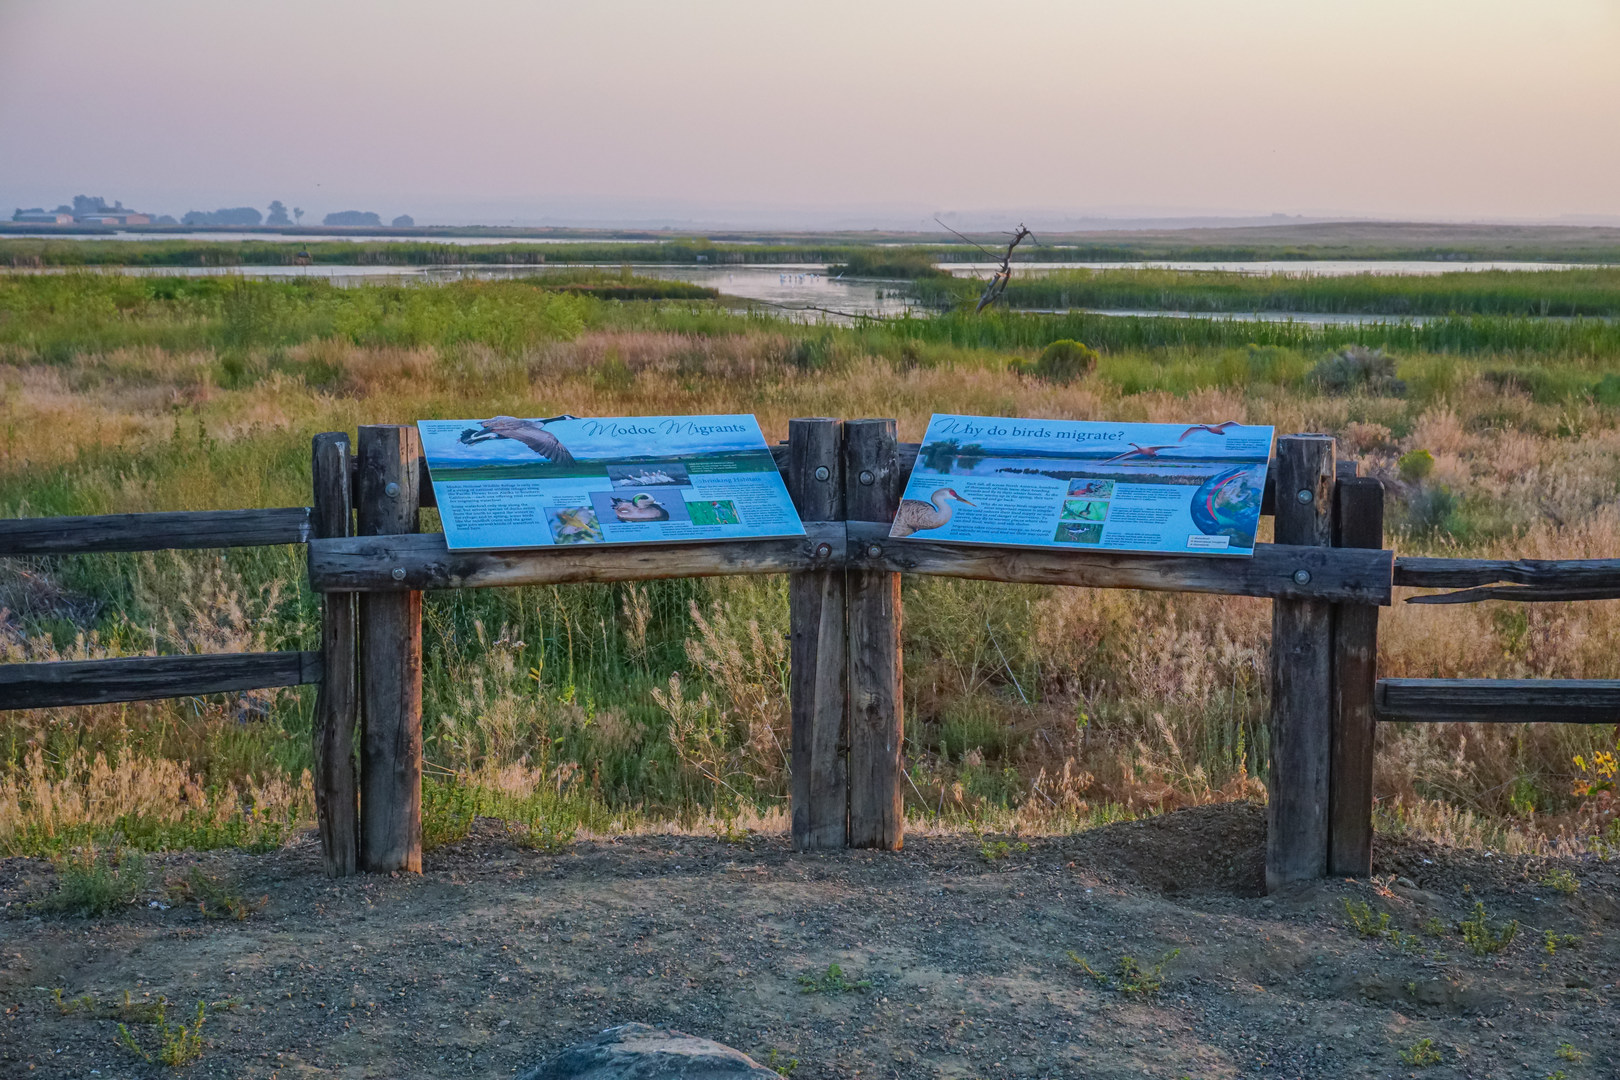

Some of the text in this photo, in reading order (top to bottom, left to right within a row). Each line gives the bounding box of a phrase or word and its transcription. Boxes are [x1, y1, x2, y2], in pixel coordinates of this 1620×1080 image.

[582, 418, 746, 438] Modoc Migrants
[934, 418, 1124, 442] Why do birds migrate?
